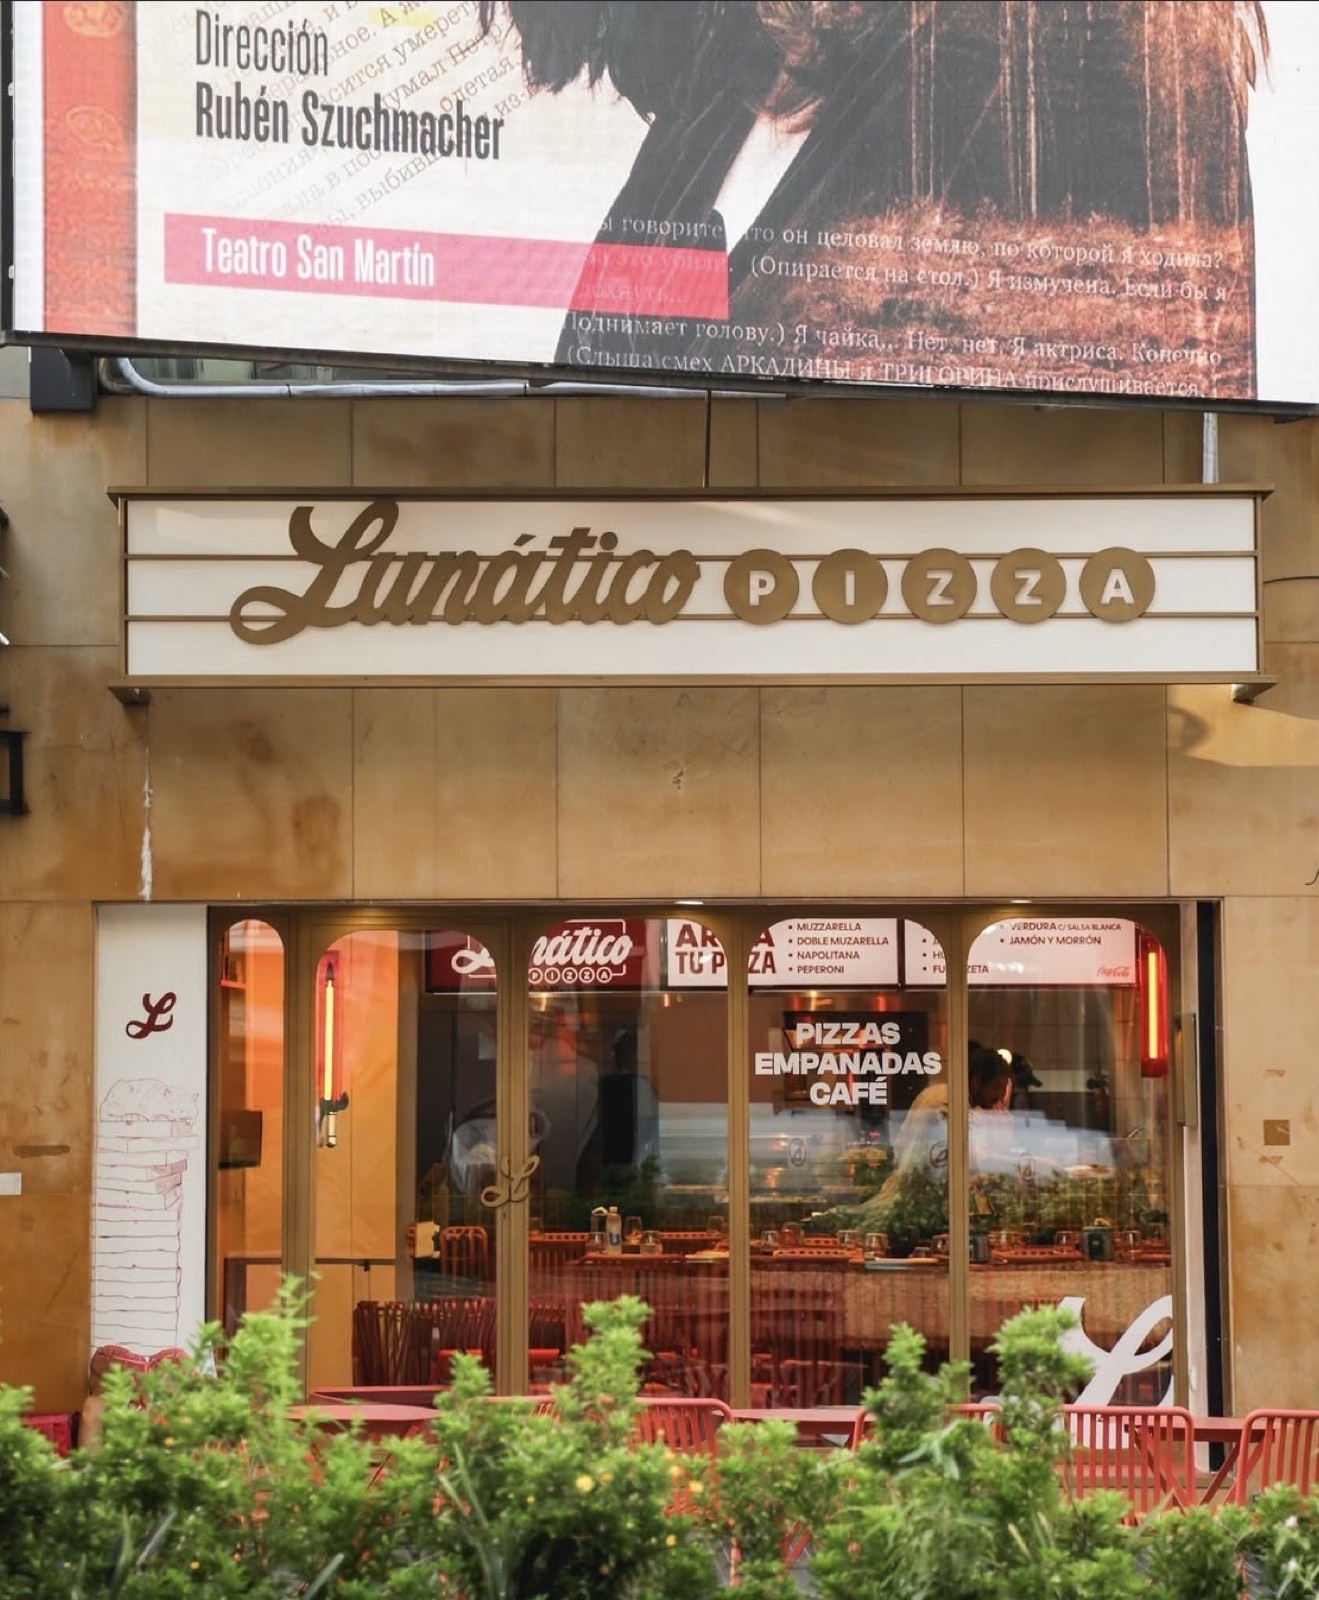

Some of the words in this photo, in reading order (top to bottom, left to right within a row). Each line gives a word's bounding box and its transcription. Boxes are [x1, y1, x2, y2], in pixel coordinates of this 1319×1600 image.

[196, 10, 328, 76] Dirección
[196, 81, 288, 143] Rubén
[302, 90, 504, 160] Szuchmacher
[202, 227, 287, 278] Teatro
[297, 233, 344, 280] San
[354, 238, 435, 287] Martín
[782, 228, 808, 245] он
[817, 230, 904, 251] целовал
[1026, 242, 1115, 267] которой
[884, 268, 909, 283] на
[987, 268, 1001, 289] Я
[793, 323, 808, 344] Я
[1012, 336, 1026, 356] Я
[661, 353, 713, 372] смех
[720, 354, 851, 380] АРКАДИНЫ
[230, 500, 700, 645] Lunático
[749, 568, 1134, 606] PIZZA
[797, 922, 862, 932] MUZZARELLA
[1011, 922, 1058, 931] VERDURA
[797, 937, 829, 946] DOBLE
[830, 937, 889, 946] MUZARELLA
[1010, 934, 1046, 945] JAMÓN
[1056, 934, 1102, 945] MORRÓN
[676, 952, 703, 974] TU
[797, 951, 861, 960] NAPOLITANA
[797, 965, 845, 974] PEPERONI
[796, 1022, 901, 1045] PIZZAS
[755, 1052, 943, 1075] EMPANADAS
[810, 1075, 888, 1106] CAFÉ
